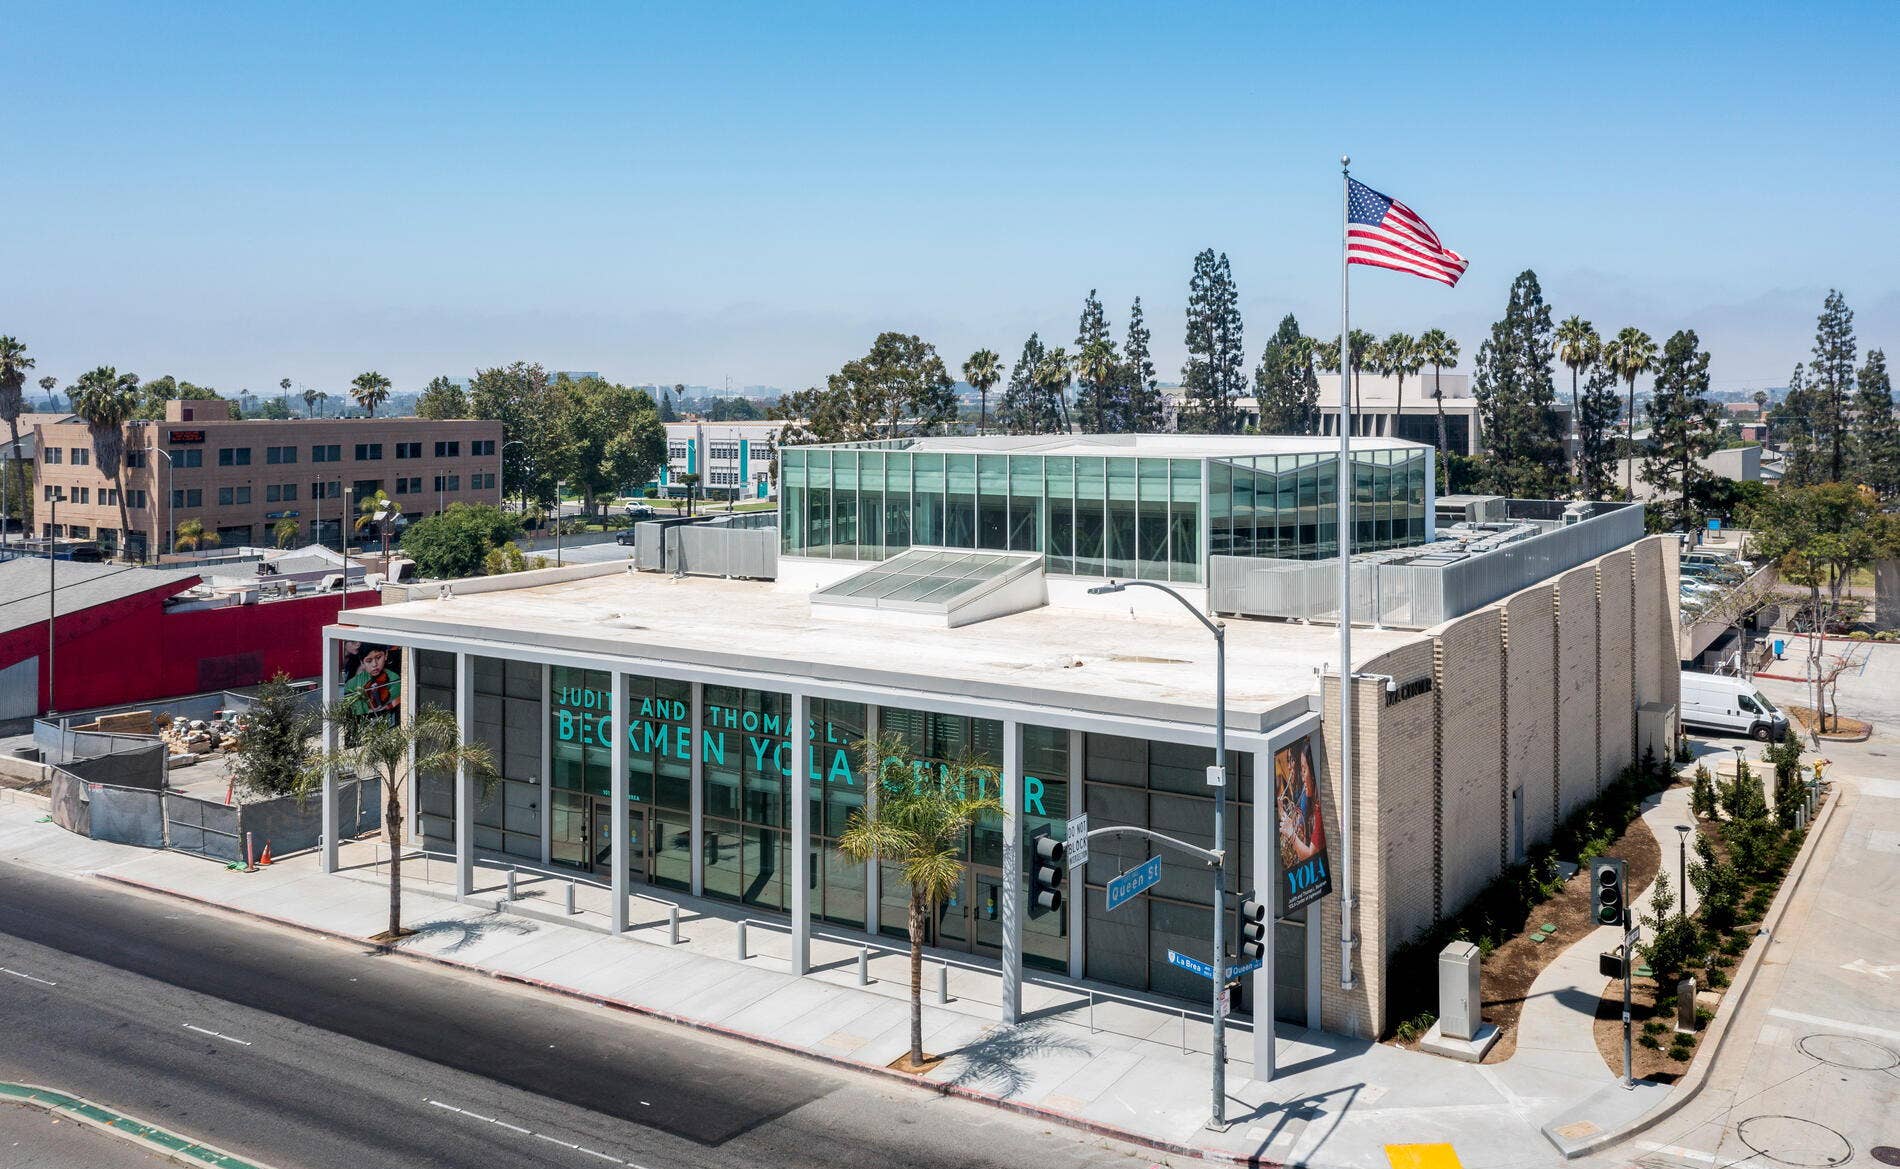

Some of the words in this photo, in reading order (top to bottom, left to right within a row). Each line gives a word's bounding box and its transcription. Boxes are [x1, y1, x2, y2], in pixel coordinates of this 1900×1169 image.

[559, 687, 612, 710] JUDIT
[640, 697, 685, 721] AND
[827, 722, 847, 745] L.
[559, 709, 724, 765] BECKMEN
[750, 736, 853, 785] YOLA
[880, 755, 1046, 816] CENTR
[1076, 820, 1087, 834] NOT
[1067, 839, 1087, 855] BLOCK
[1112, 874, 1145, 901] Queen
[1148, 864, 1158, 880] St
[1288, 857, 1326, 895] YOLA
[1176, 956, 1185, 966] La
[1185, 959, 1201, 973] Brea
[1232, 963, 1254, 976] Queen
